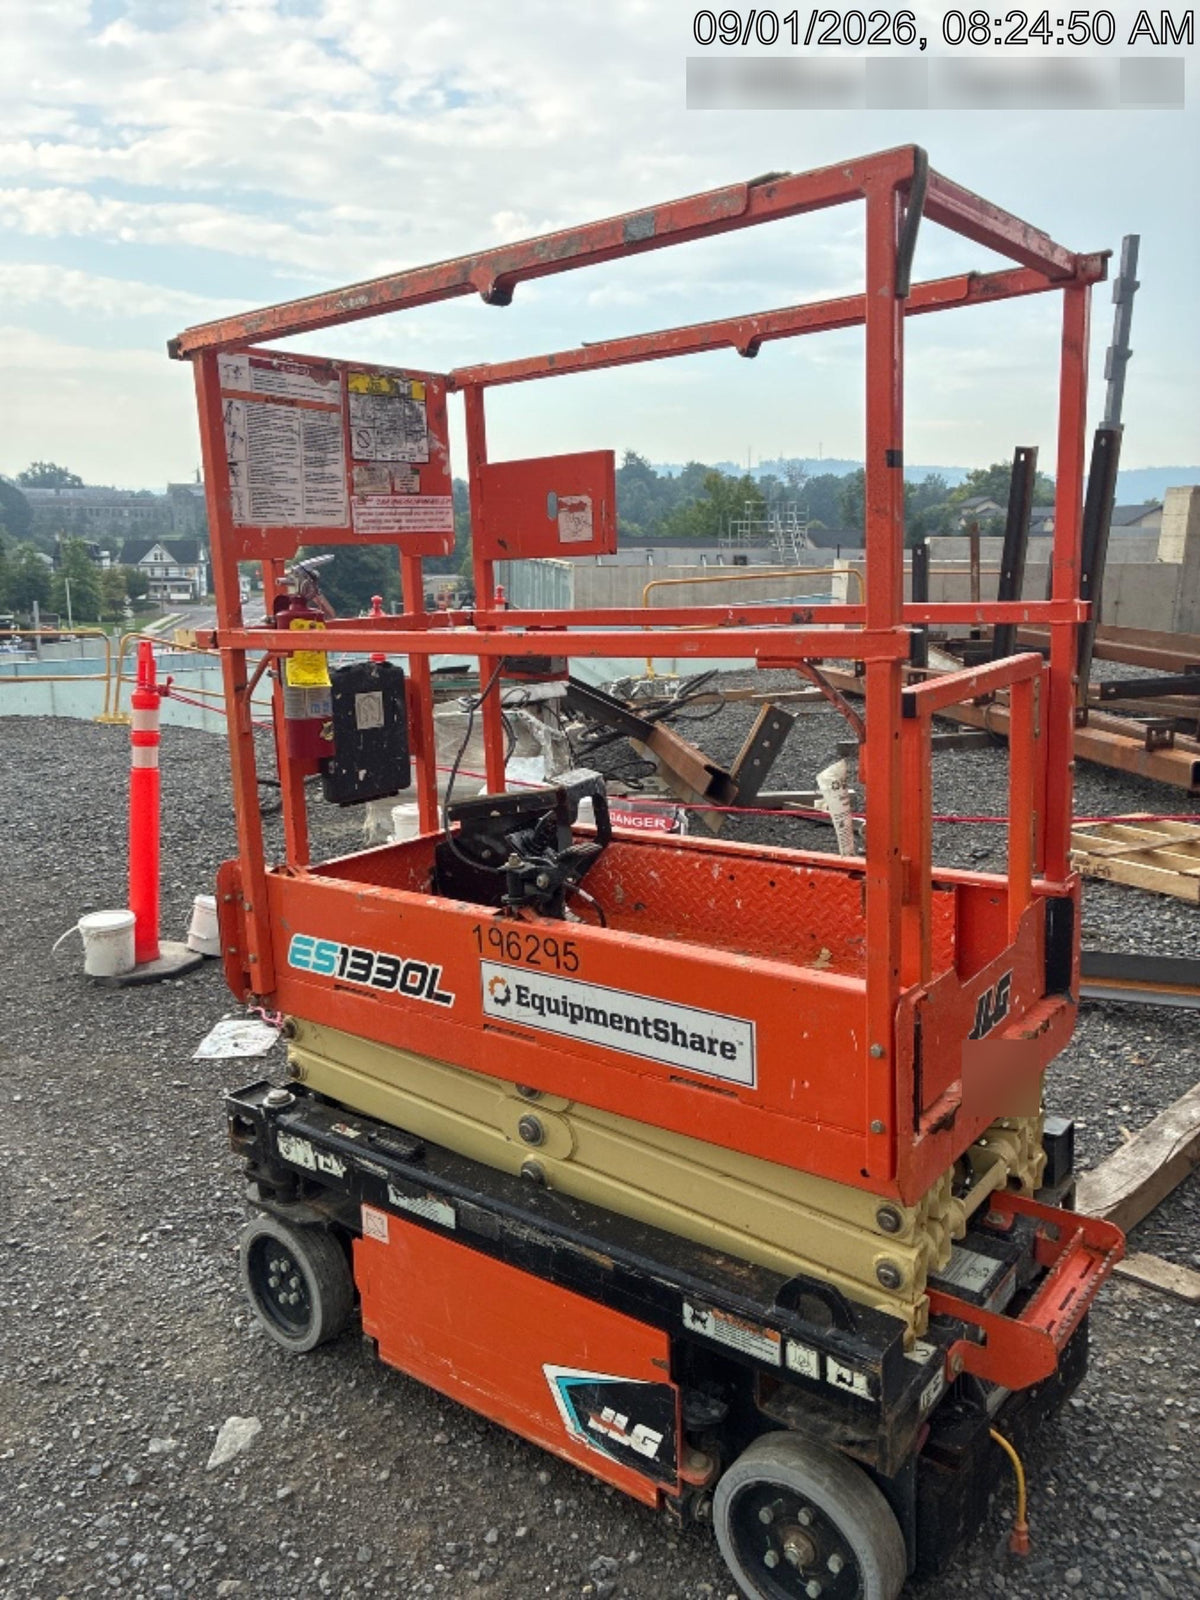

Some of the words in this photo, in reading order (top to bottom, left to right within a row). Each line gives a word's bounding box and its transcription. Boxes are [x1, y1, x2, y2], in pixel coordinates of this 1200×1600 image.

[289, 934, 455, 1007] ES1330L
[473, 924, 579, 972] 196295
[515, 984, 738, 1061] EquipmentShare
[588, 1406, 664, 1459] JLG
